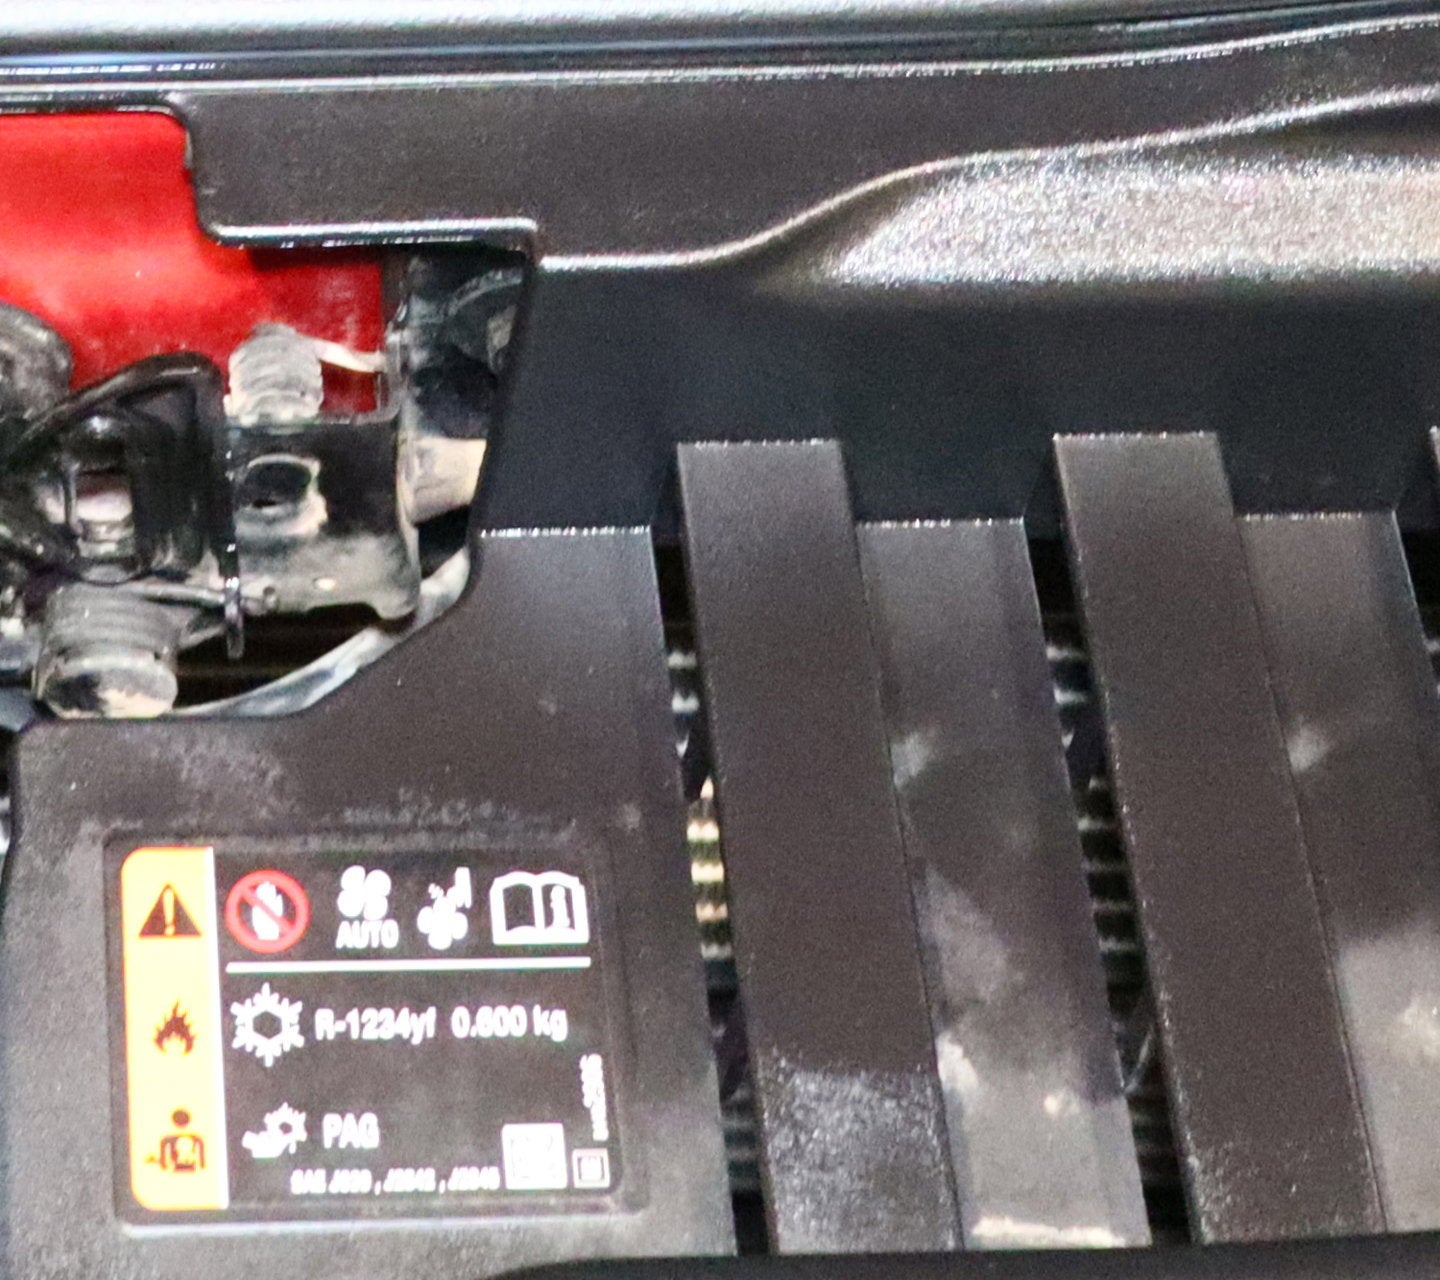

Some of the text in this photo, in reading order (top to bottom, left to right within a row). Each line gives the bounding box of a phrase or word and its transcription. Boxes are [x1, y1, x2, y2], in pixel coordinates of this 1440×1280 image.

[335, 919, 400, 949] AUTO
[314, 1006, 438, 1045] R-1234yf
[532, 1004, 568, 1042] kg
[322, 1112, 380, 1149] PAG
